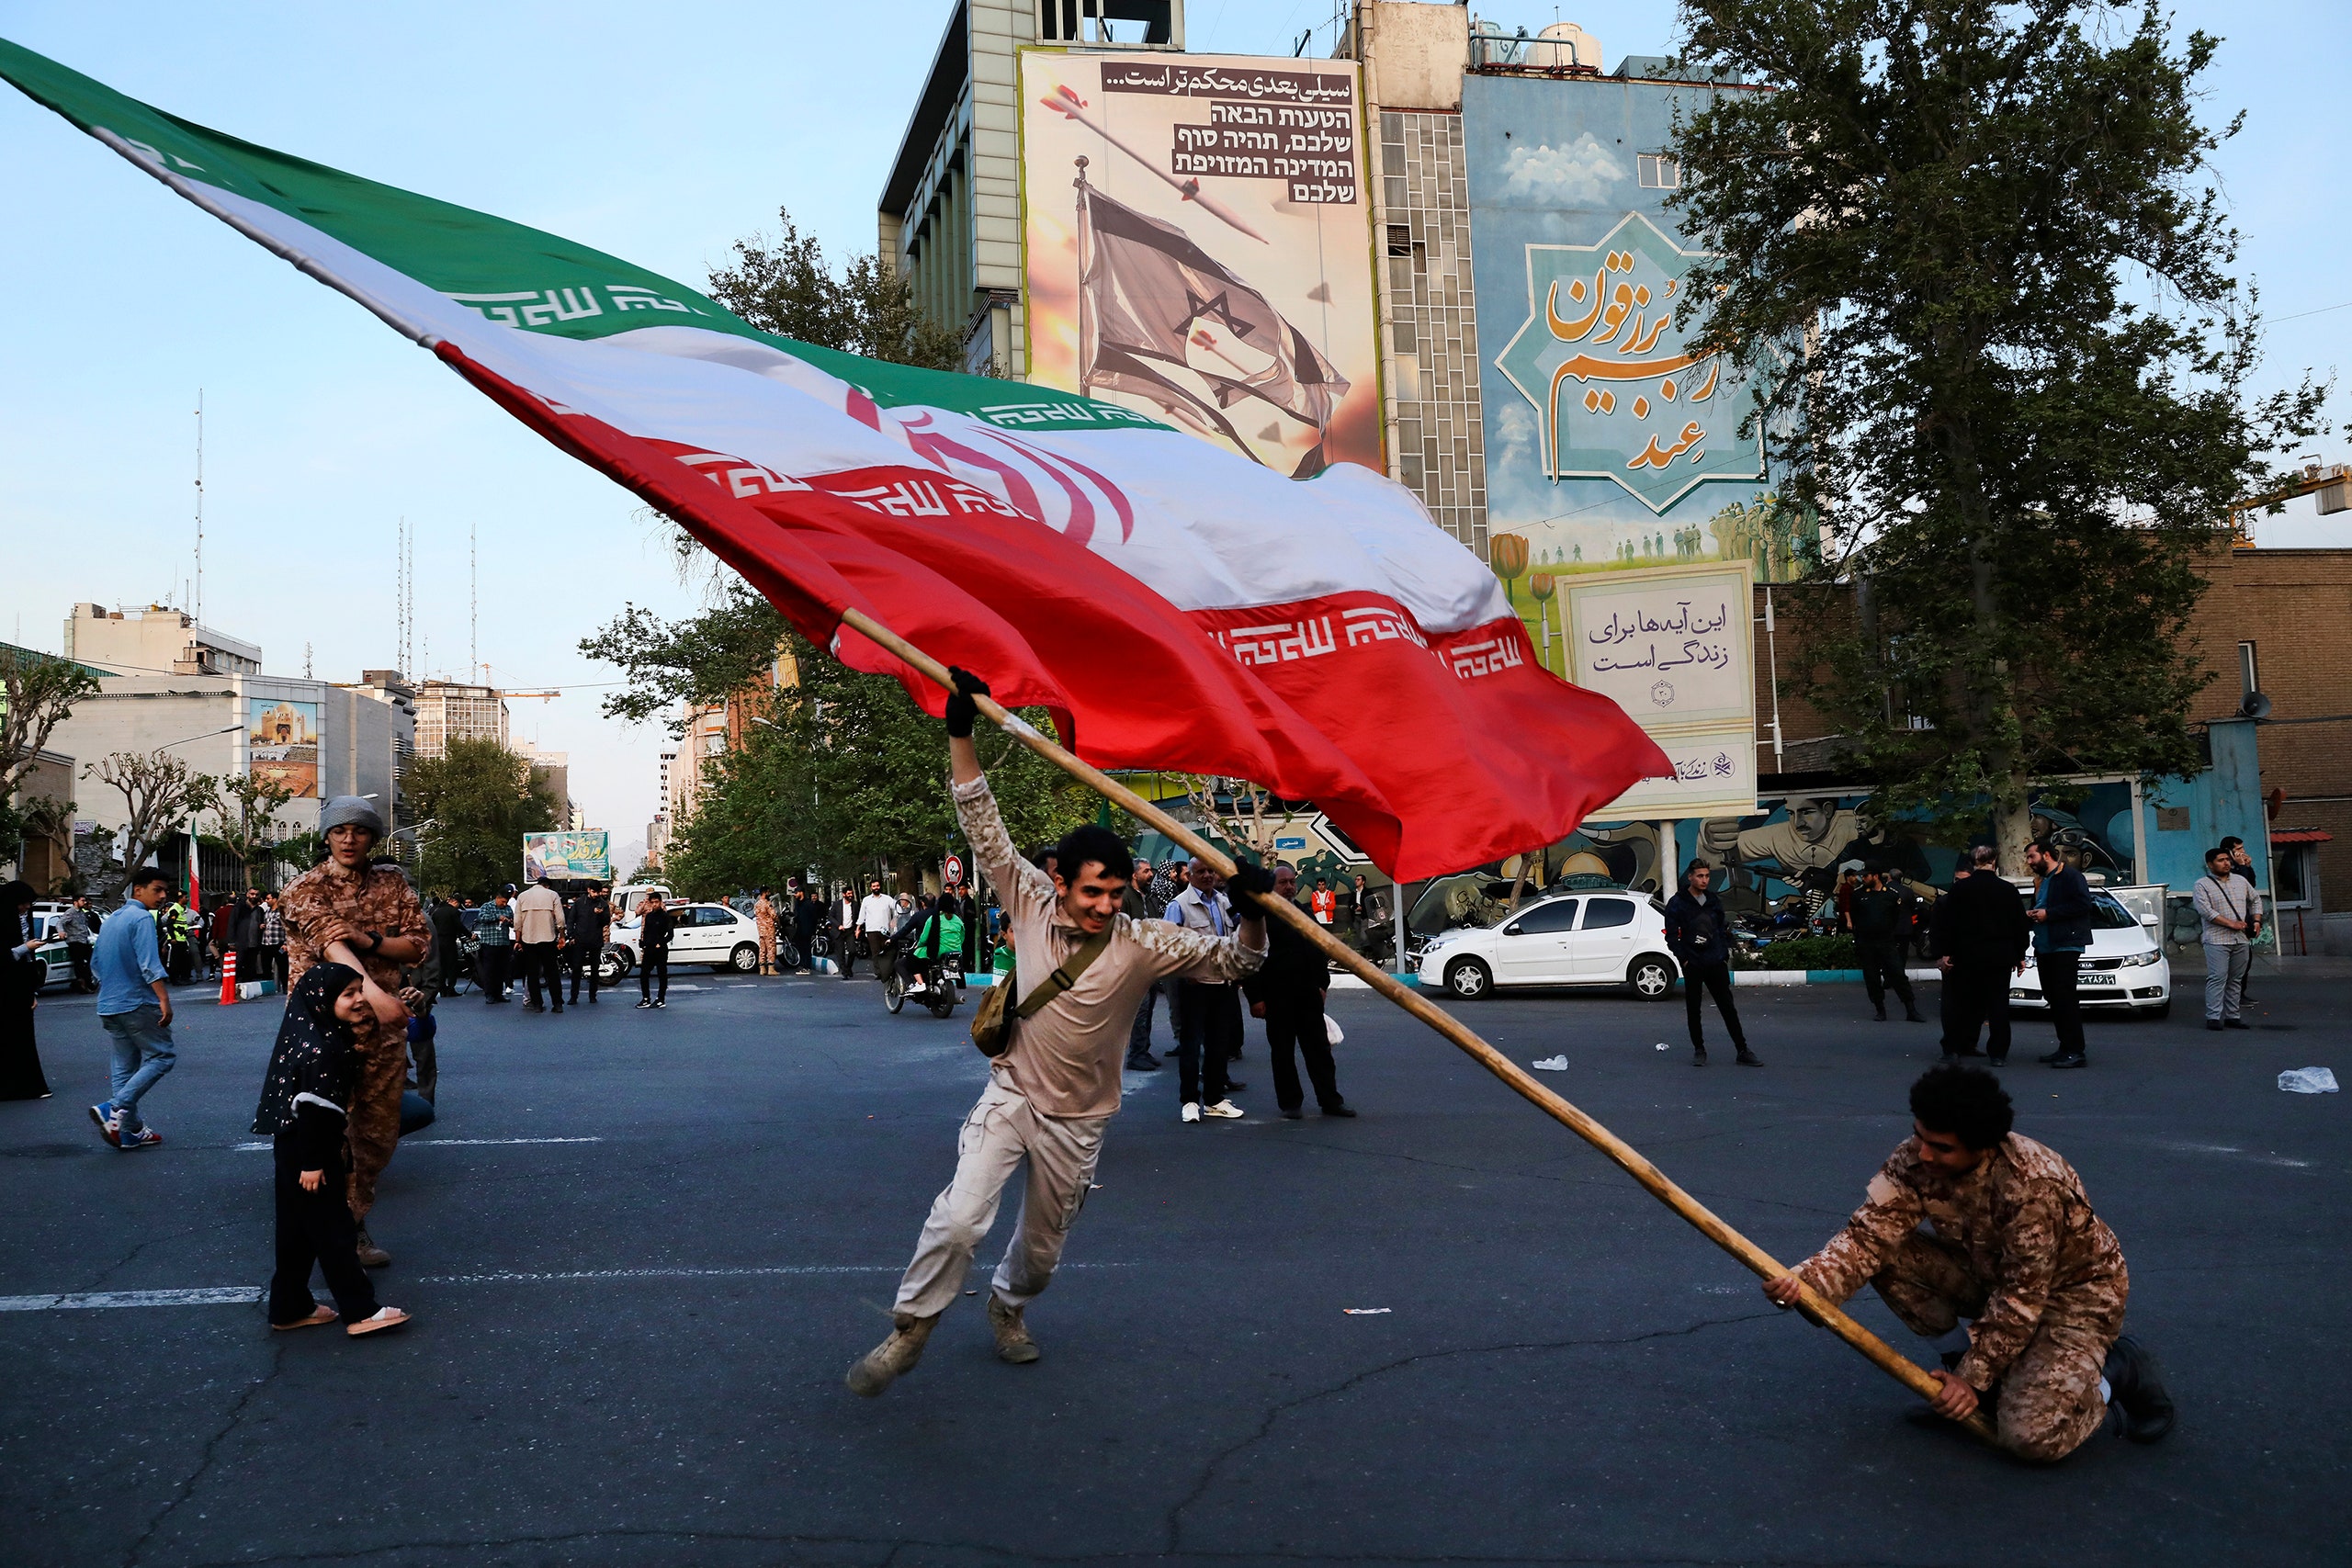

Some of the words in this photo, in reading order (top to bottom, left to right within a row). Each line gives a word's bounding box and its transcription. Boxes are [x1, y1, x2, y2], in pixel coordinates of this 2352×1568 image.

[1248, 76, 1299, 101] بعدی
[1298, 74, 1351, 103] سیلی
[1211, 104, 1273, 126] הבאה
[1278, 107, 1351, 130] הטעות
[1177, 128, 1218, 152] סוף
[1223, 130, 1279, 151] תהיה
[1283, 130, 1351, 154] שלכם,
[1175, 152, 1269, 175] המזויפת
[1273, 157, 1353, 178] המדינה
[1293, 179, 1355, 203] שלכם
[1589, 612, 1635, 645] برای
[1690, 603, 1726, 635] این
[1592, 643, 1656, 672] است
